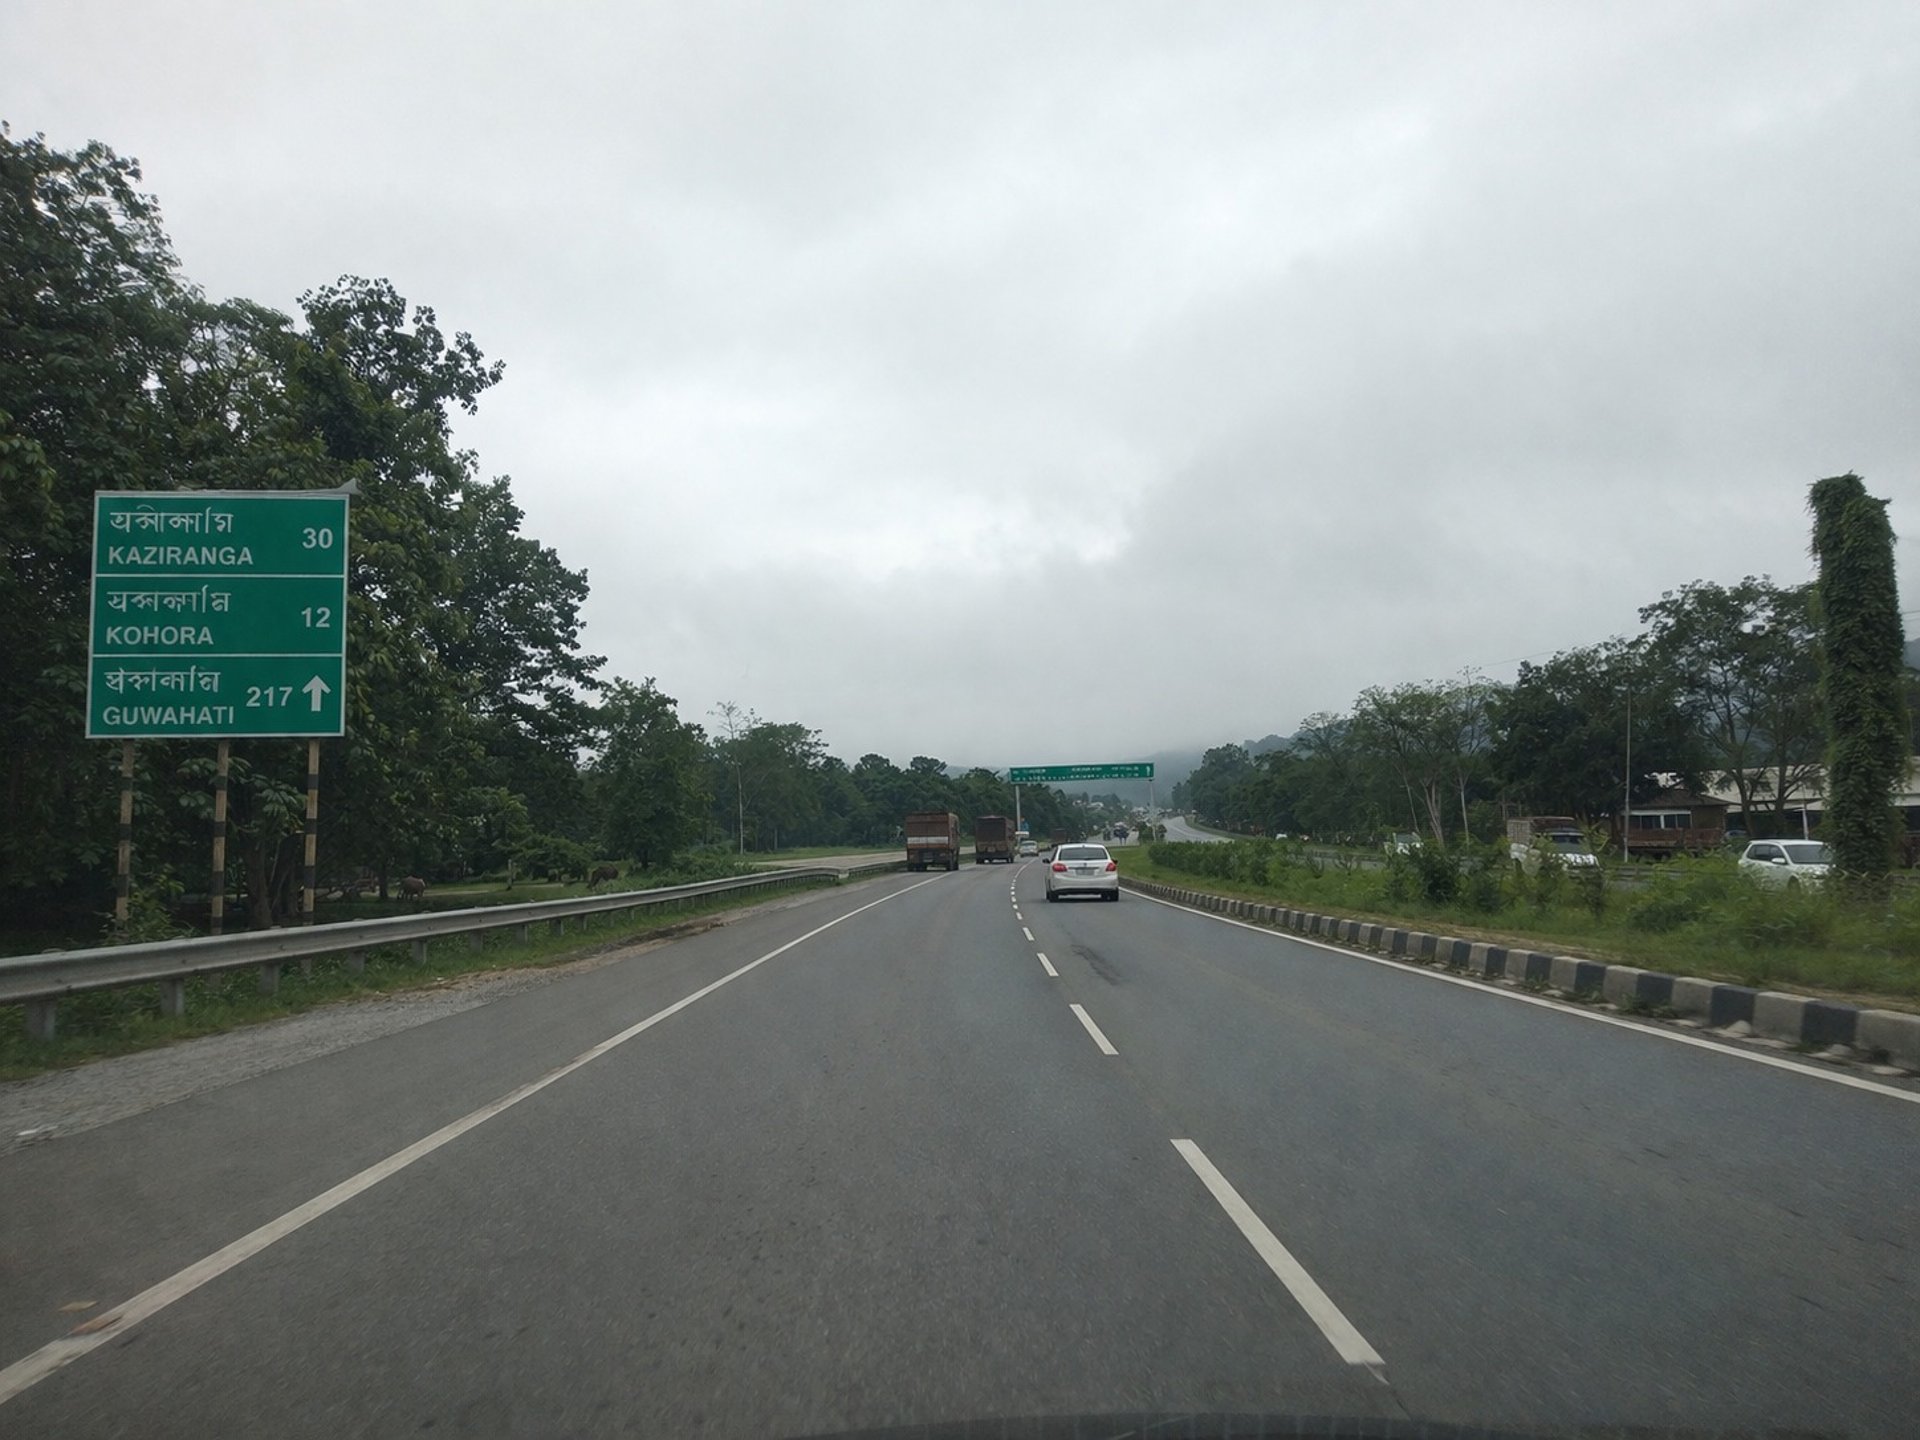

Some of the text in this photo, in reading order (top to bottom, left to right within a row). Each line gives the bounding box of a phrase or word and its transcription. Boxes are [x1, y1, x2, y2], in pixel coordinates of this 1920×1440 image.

[302, 528, 333, 549] 30
[108, 546, 253, 565] KAZIRANGA
[301, 607, 331, 628] 12
[106, 626, 214, 645] KOHORA
[246, 686, 293, 707] 217
[103, 706, 234, 725] GUWAHATI
